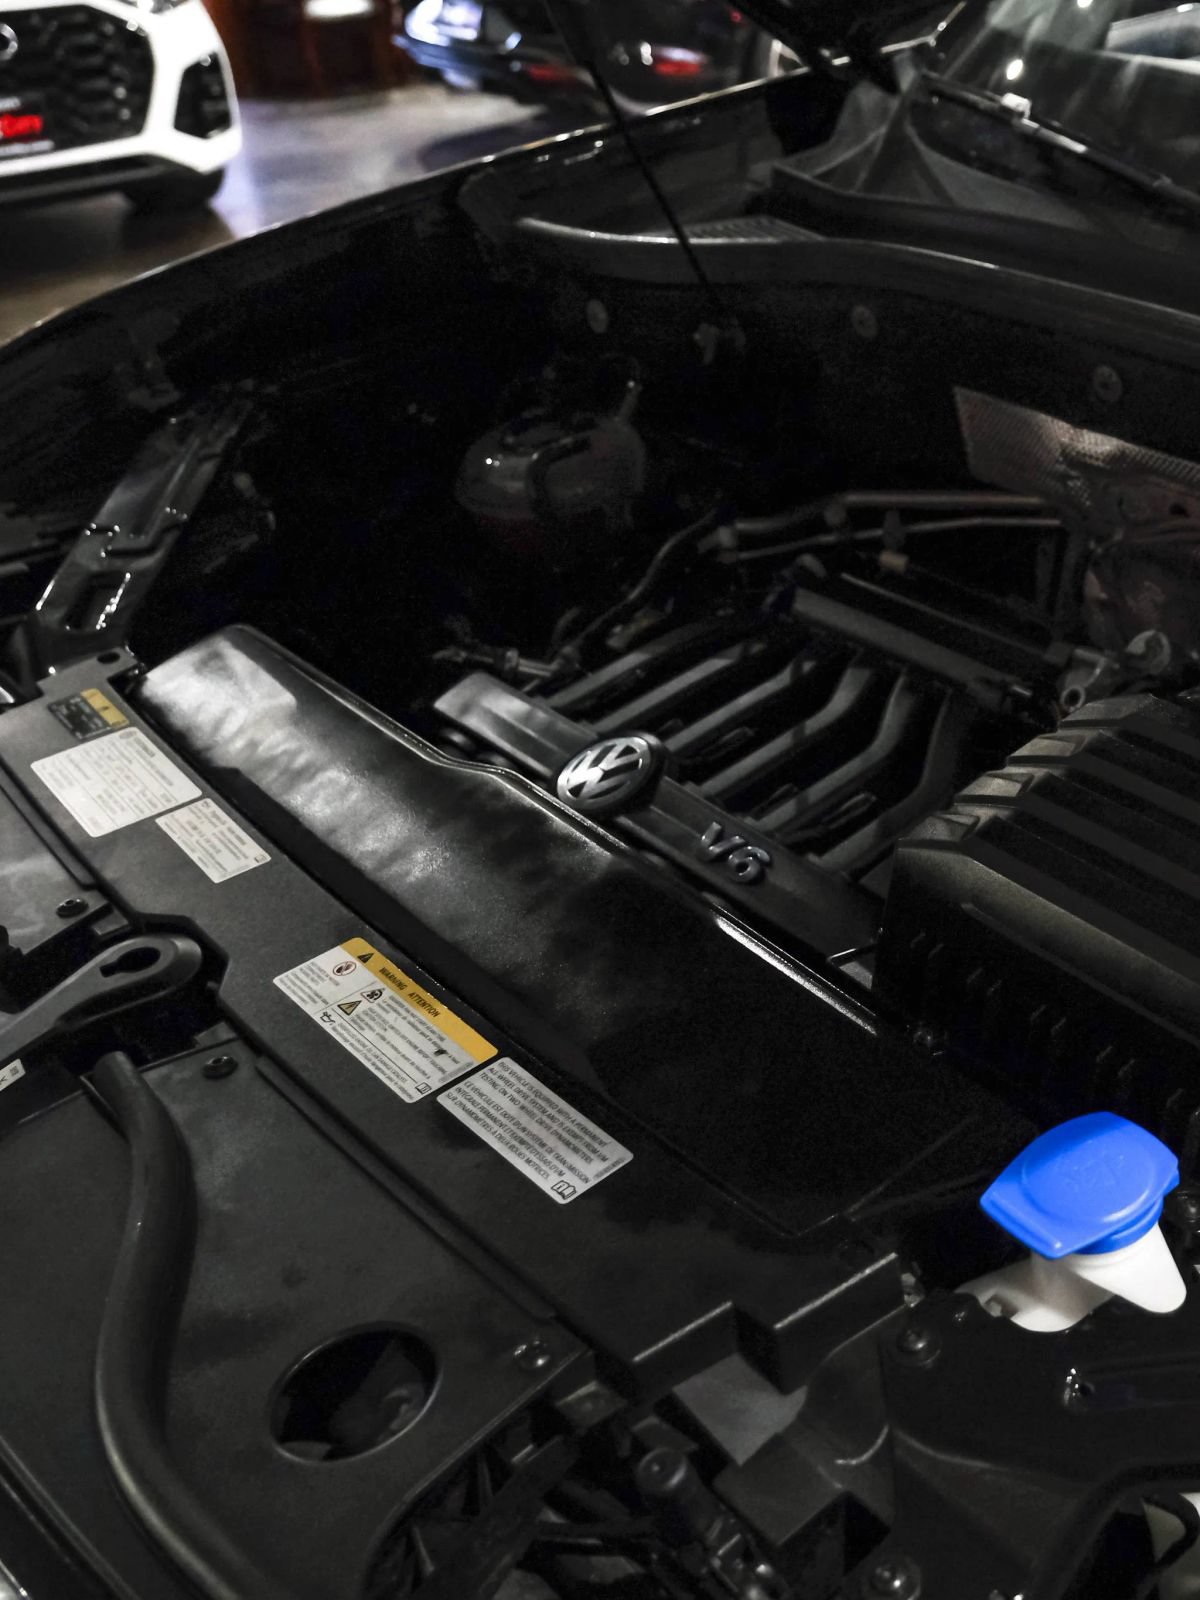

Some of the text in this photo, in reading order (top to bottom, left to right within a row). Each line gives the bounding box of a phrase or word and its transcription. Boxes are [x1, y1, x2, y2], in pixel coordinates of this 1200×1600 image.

[700, 821, 771, 882] V6
[378, 967, 407, 990] WARNING
[407, 991, 440, 1016] ATTENTION
[479, 1072, 500, 1089] TESTING
[498, 1087, 509, 1095] ON
[506, 1094, 521, 1105] TWO
[518, 1104, 538, 1119] WHEEL
[497, 1074, 516, 1088] WHEEL
[513, 1087, 530, 1099] DRIVE
[528, 1098, 548, 1114] SYSTEM
[545, 1112, 560, 1123] AND
[507, 1070, 529, 1086] VEHICLE
[491, 1103, 502, 1111] EST
